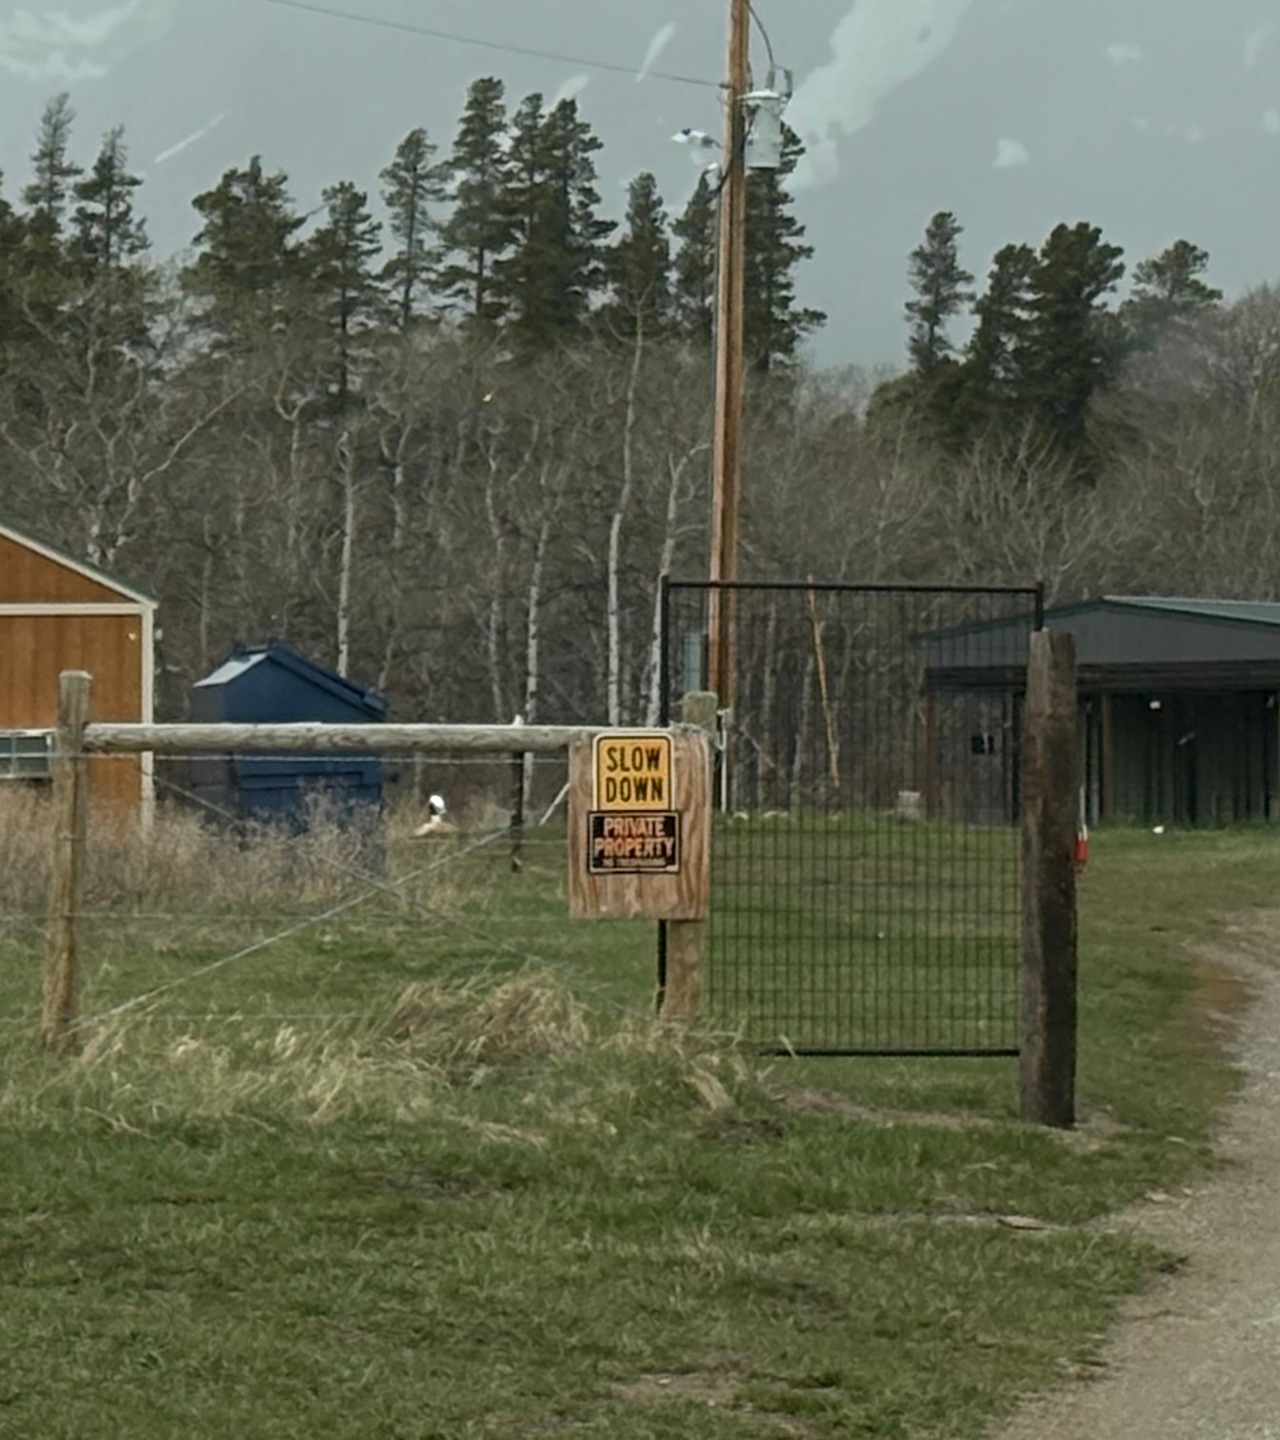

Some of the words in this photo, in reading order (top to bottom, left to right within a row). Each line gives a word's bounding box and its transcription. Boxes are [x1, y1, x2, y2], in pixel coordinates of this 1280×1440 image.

[606, 746, 661, 772] SLOW
[606, 777, 663, 803] DOWN
[604, 817, 666, 836] PRIVATE
[594, 837, 674, 857] PROPERTY
